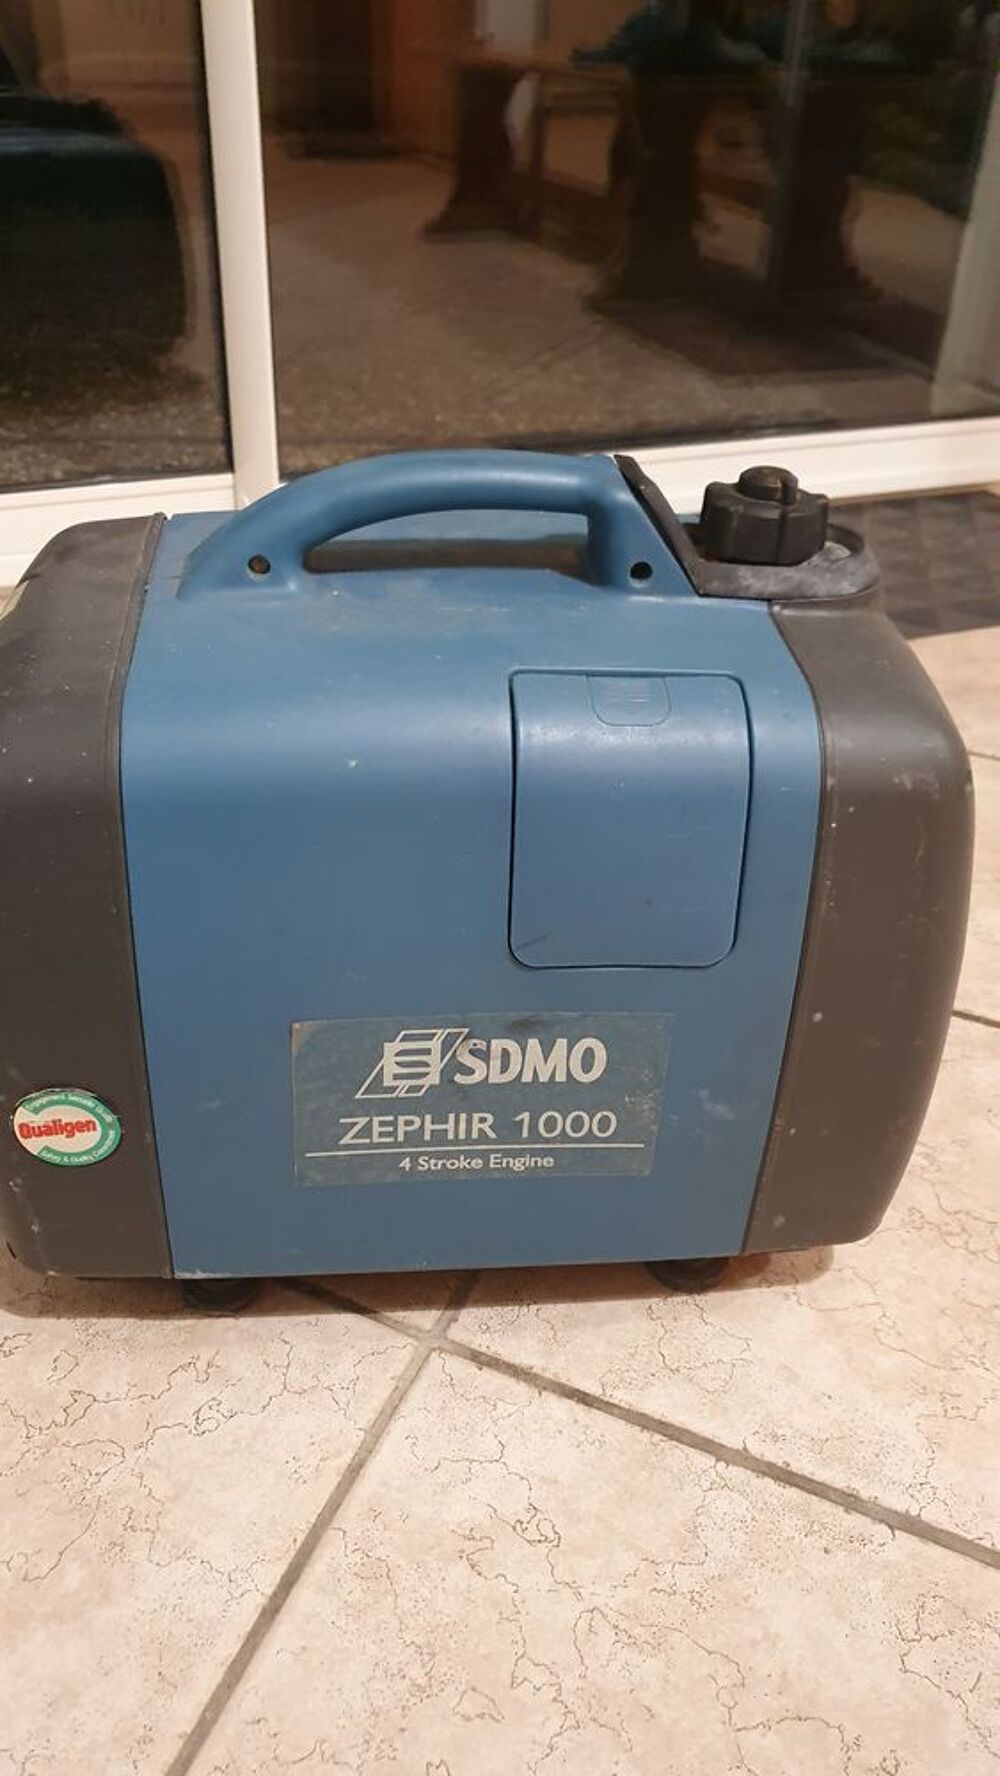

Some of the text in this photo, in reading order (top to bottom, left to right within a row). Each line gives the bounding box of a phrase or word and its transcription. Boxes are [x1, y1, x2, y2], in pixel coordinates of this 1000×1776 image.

[453, 1036, 608, 1085] SDMO
[17, 1117, 98, 1139] Qualigen
[337, 1110, 618, 1146] ZEPHIR 1000
[398, 1153, 555, 1172] 4 Stroke Engine
